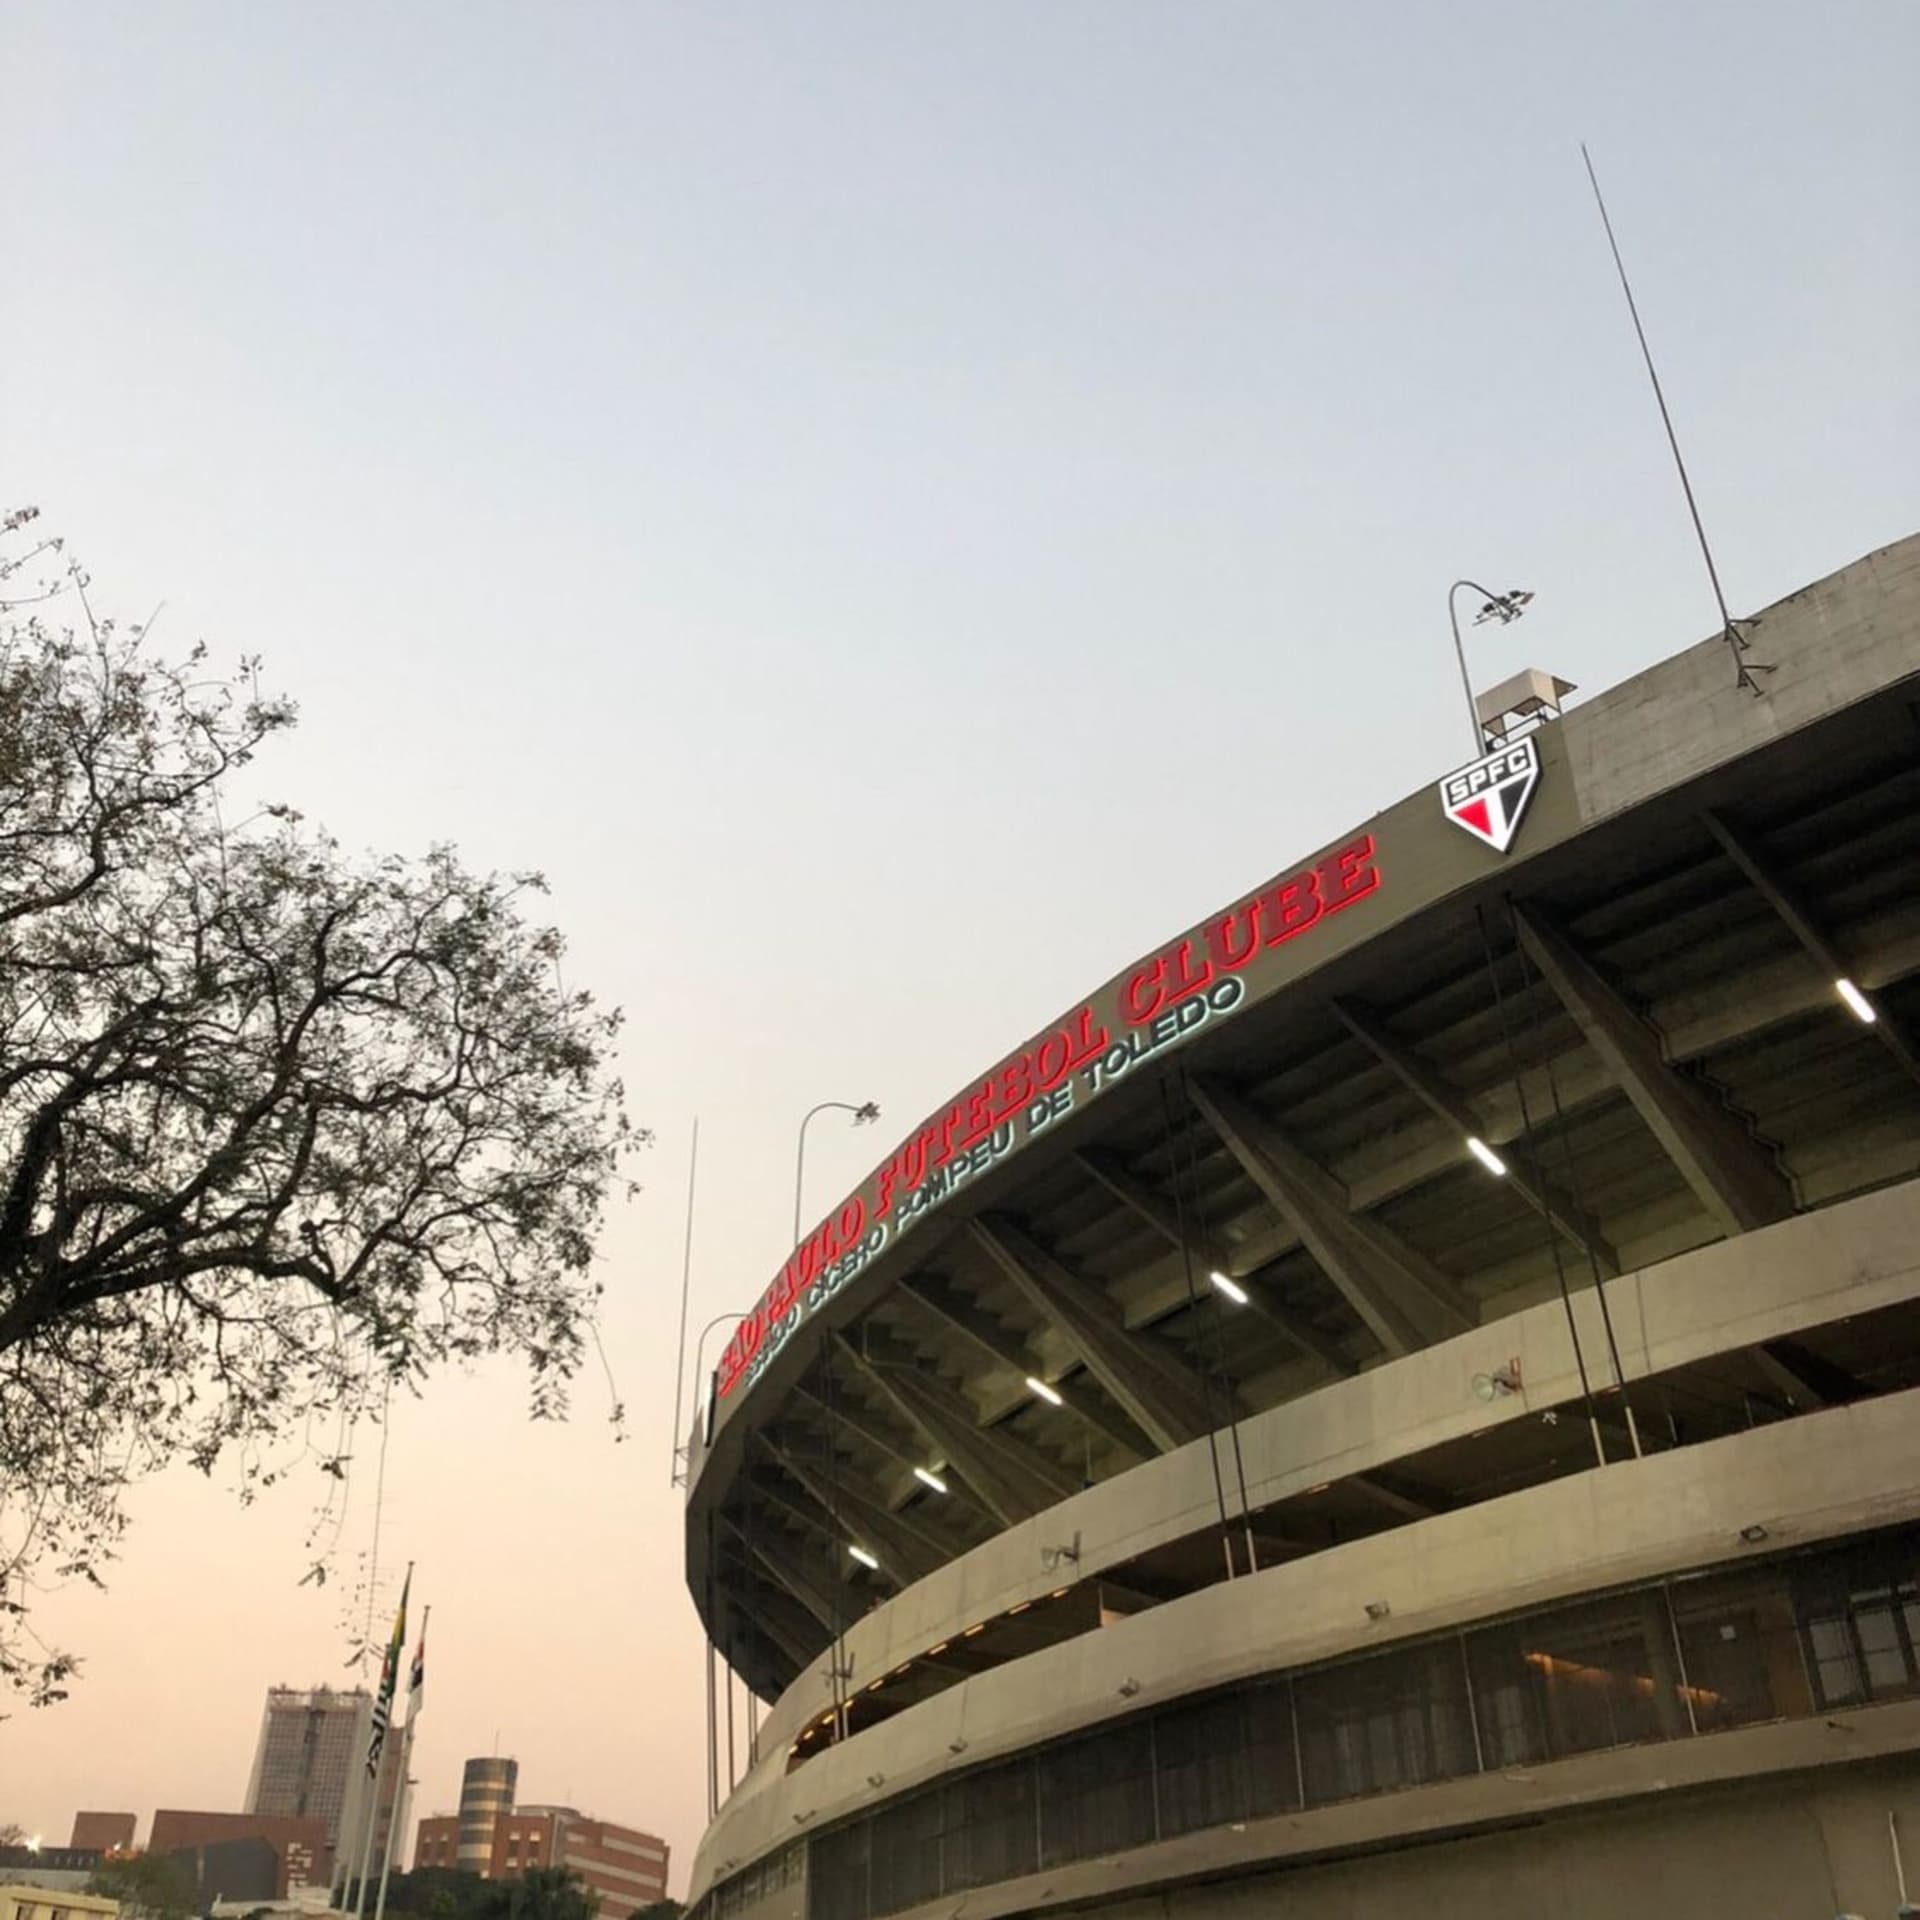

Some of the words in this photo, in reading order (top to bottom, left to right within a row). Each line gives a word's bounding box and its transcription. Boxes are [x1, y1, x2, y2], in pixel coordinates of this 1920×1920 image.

[1449, 748, 1529, 804] SPFC
[873, 1005, 1110, 1221] FUTEBOL
[1118, 834, 1382, 1026] CLUBE
[894, 1119, 1016, 1233] POMPEU
[1027, 1078, 1075, 1136] DE
[1081, 975, 1246, 1093] TOLEDO
